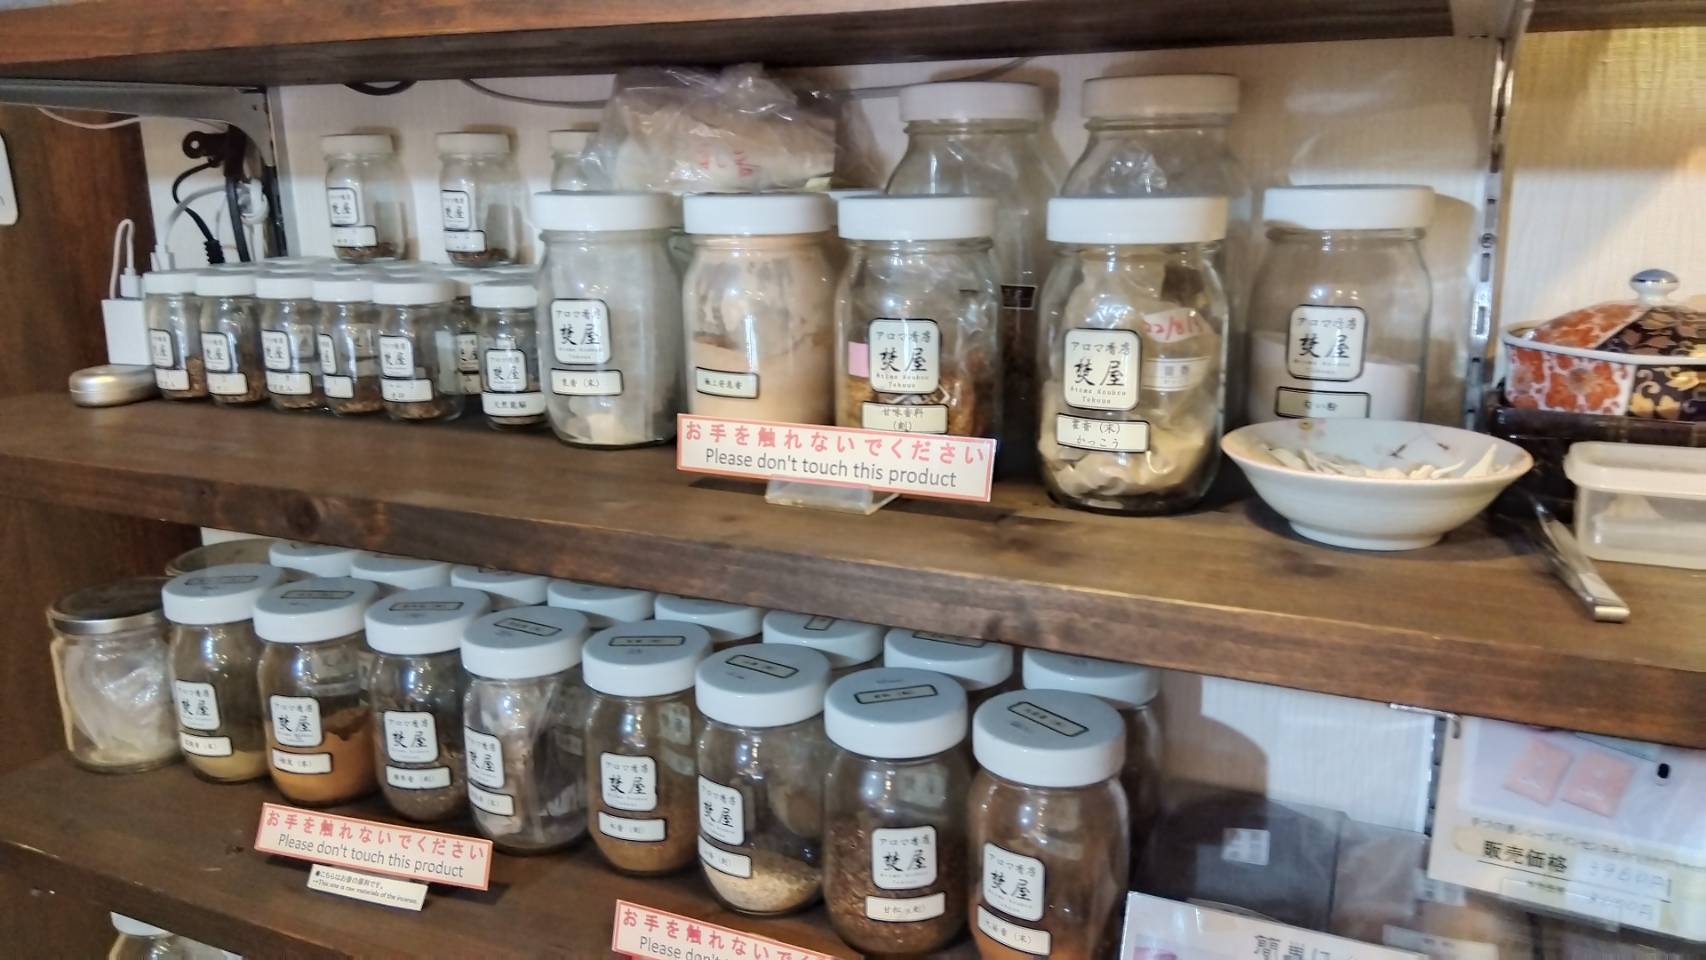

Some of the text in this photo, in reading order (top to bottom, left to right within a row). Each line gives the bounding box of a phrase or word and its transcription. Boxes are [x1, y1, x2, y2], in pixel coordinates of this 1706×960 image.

[686, 421, 984, 465] お手を触れないでください
[706, 448, 957, 488] Please don't touch this product
[267, 811, 484, 860] お手を触れないでください
[278, 833, 464, 878] Please don't touch this product
[1484, 840, 1568, 874] 販売価格
[640, 935, 681, 959] Please
